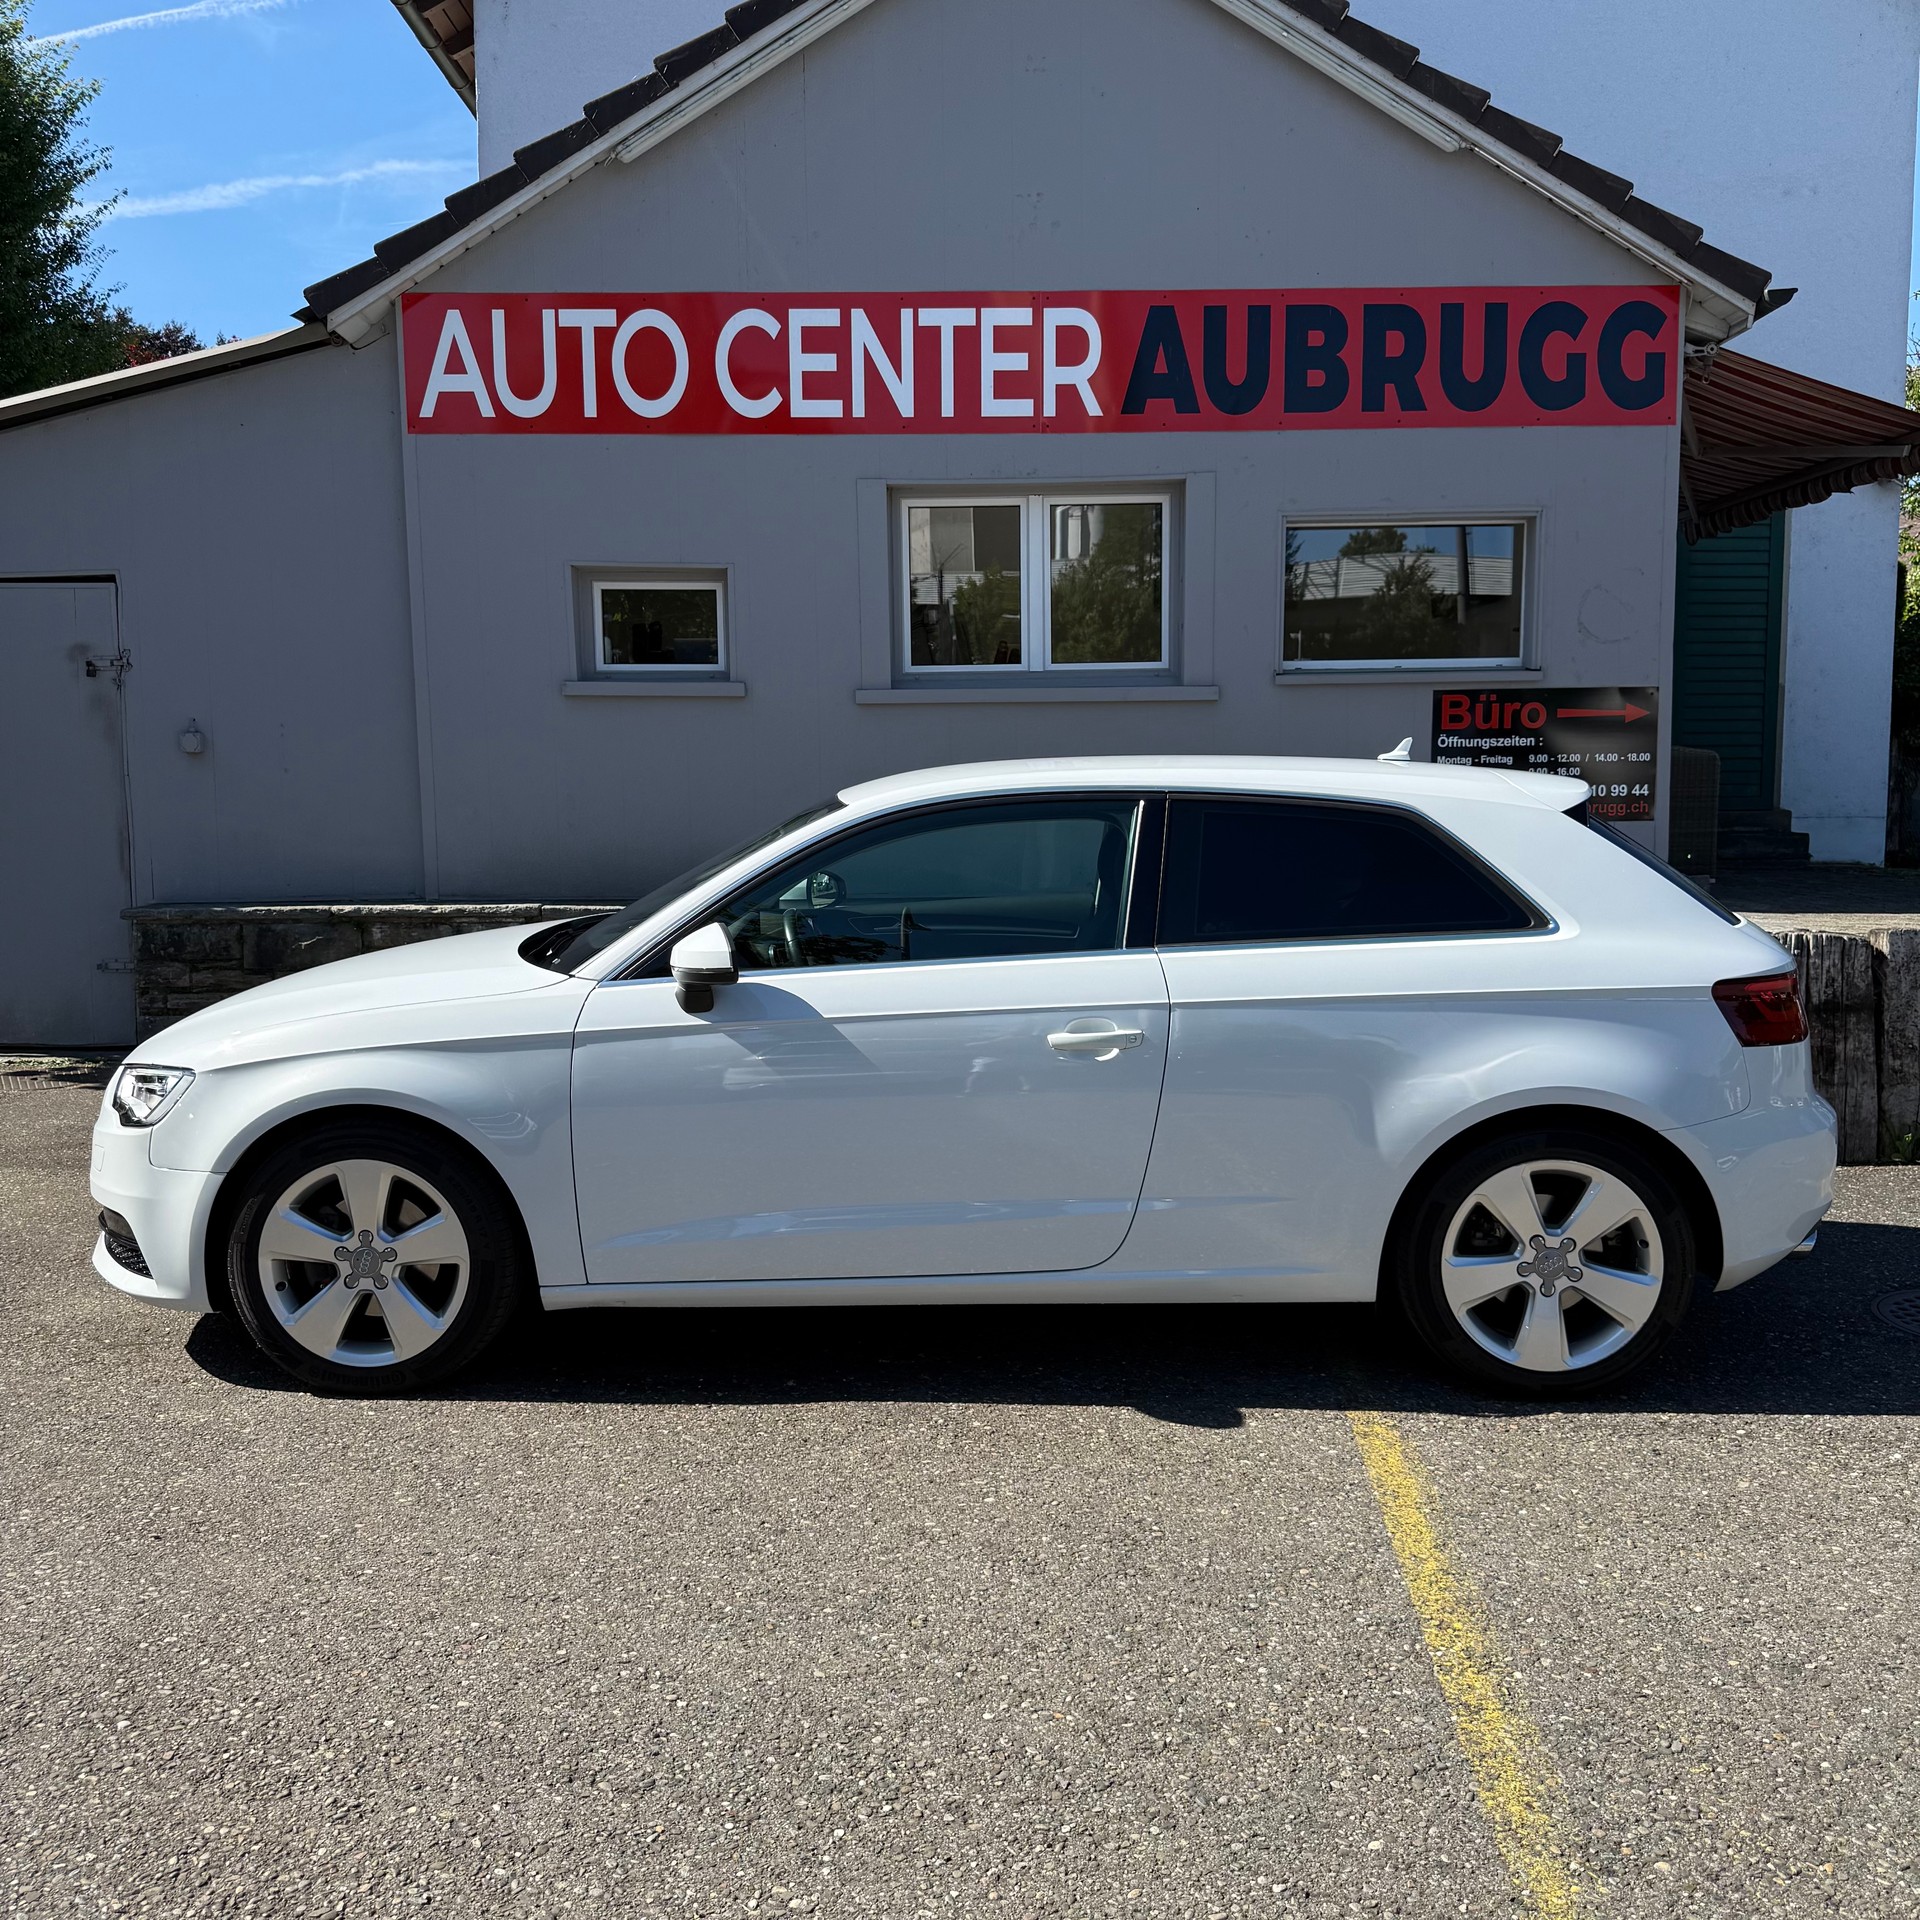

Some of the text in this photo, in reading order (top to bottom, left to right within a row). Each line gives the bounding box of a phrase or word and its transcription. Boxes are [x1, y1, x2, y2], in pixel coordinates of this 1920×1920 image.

[418, 300, 1668, 419] AUTO CENTER AUBRUGG
[1441, 694, 1548, 730] Büro
[1437, 734, 1535, 750] Öffnungszeiten
[1436, 755, 1472, 766] Montag
[1480, 754, 1513, 765] Freitag
[1528, 753, 1548, 763] 9.00
[1556, 753, 1581, 762] 12.00
[1594, 753, 1618, 762] 14.00
[1626, 752, 1651, 762] 18.00
[1556, 767, 1580, 776] 16.00
[1610, 784, 1628, 797] 99
[1631, 783, 1649, 797] 44
